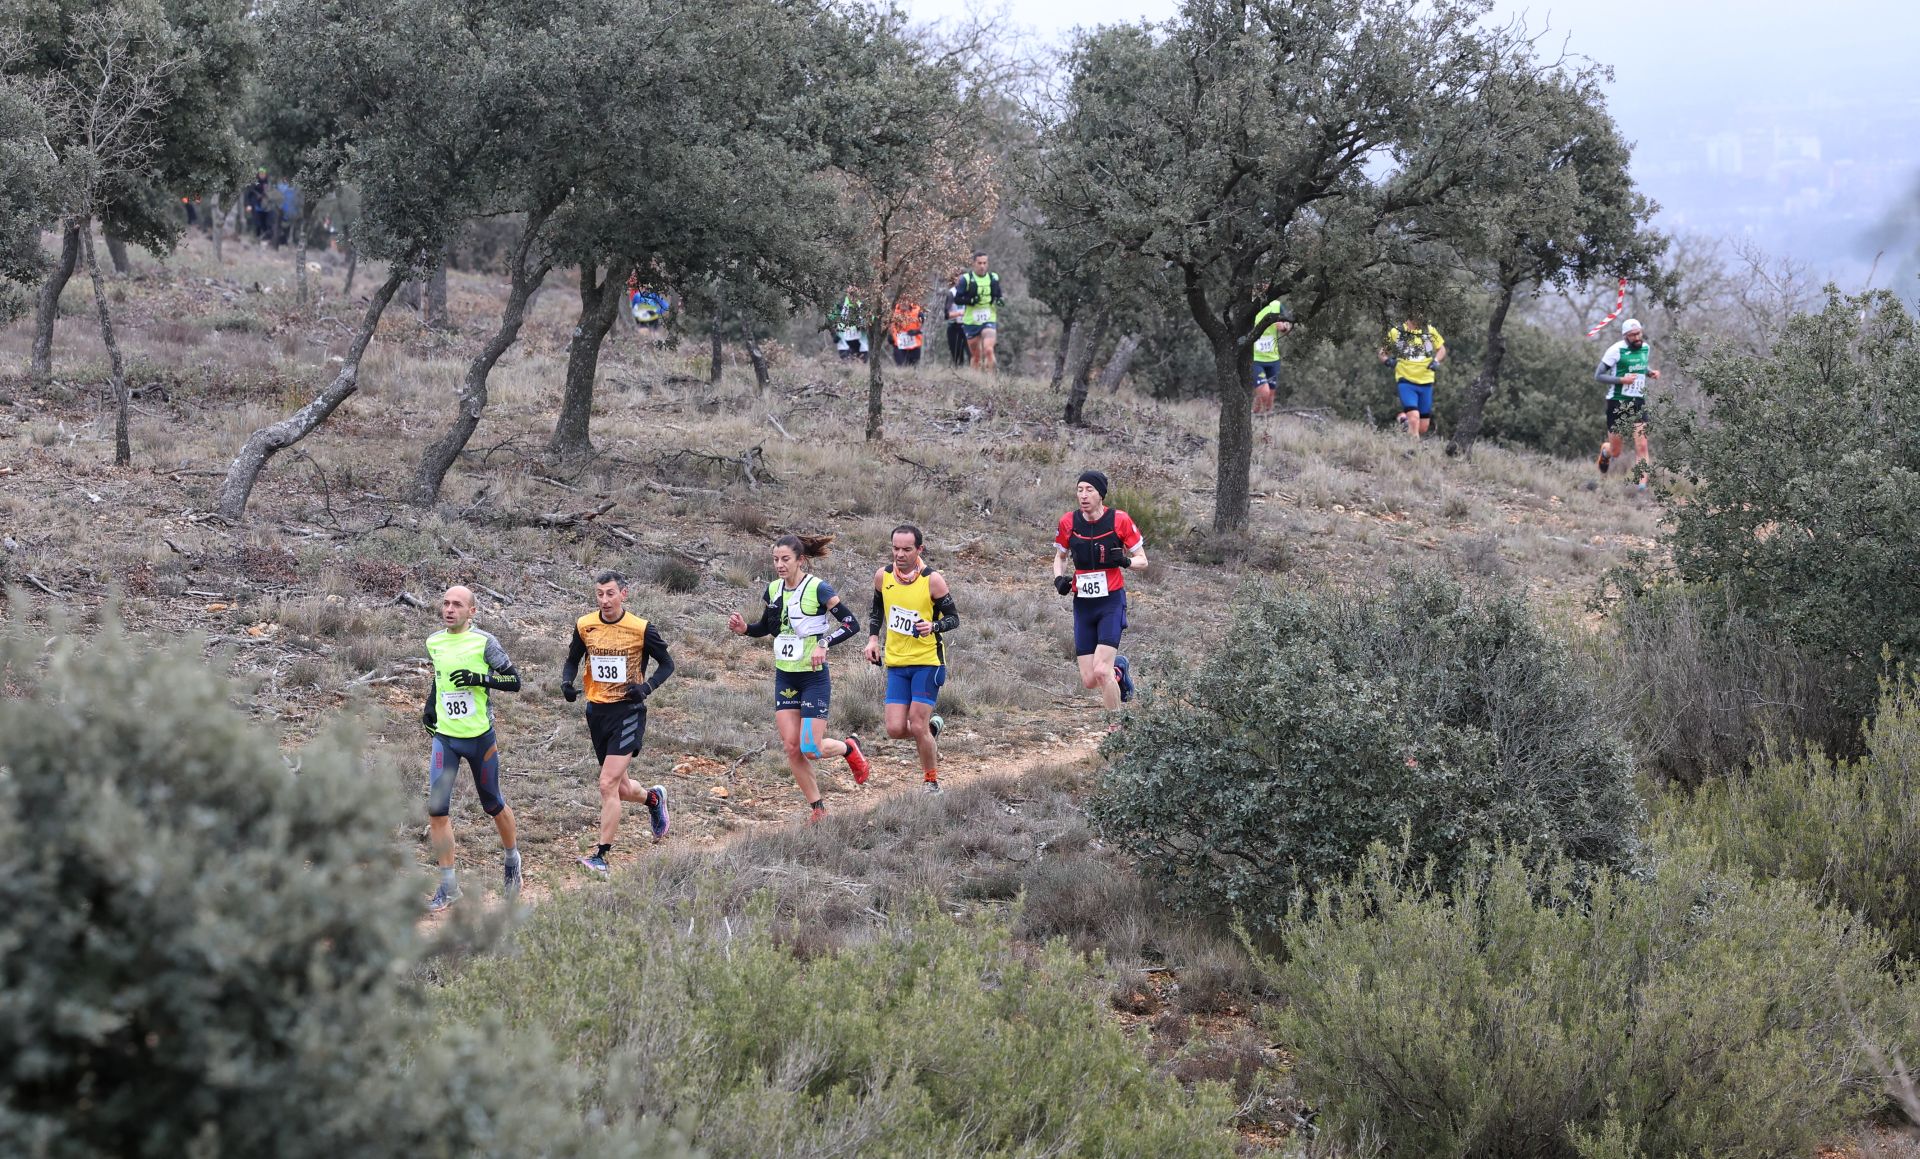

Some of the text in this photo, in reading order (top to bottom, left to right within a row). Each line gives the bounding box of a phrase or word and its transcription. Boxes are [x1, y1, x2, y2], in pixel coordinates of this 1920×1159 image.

[1082, 581, 1100, 595] 485
[894, 615, 911, 631] 370
[781, 644, 794, 658] 42
[597, 665, 618, 679] 338
[446, 700, 468, 716] 383
